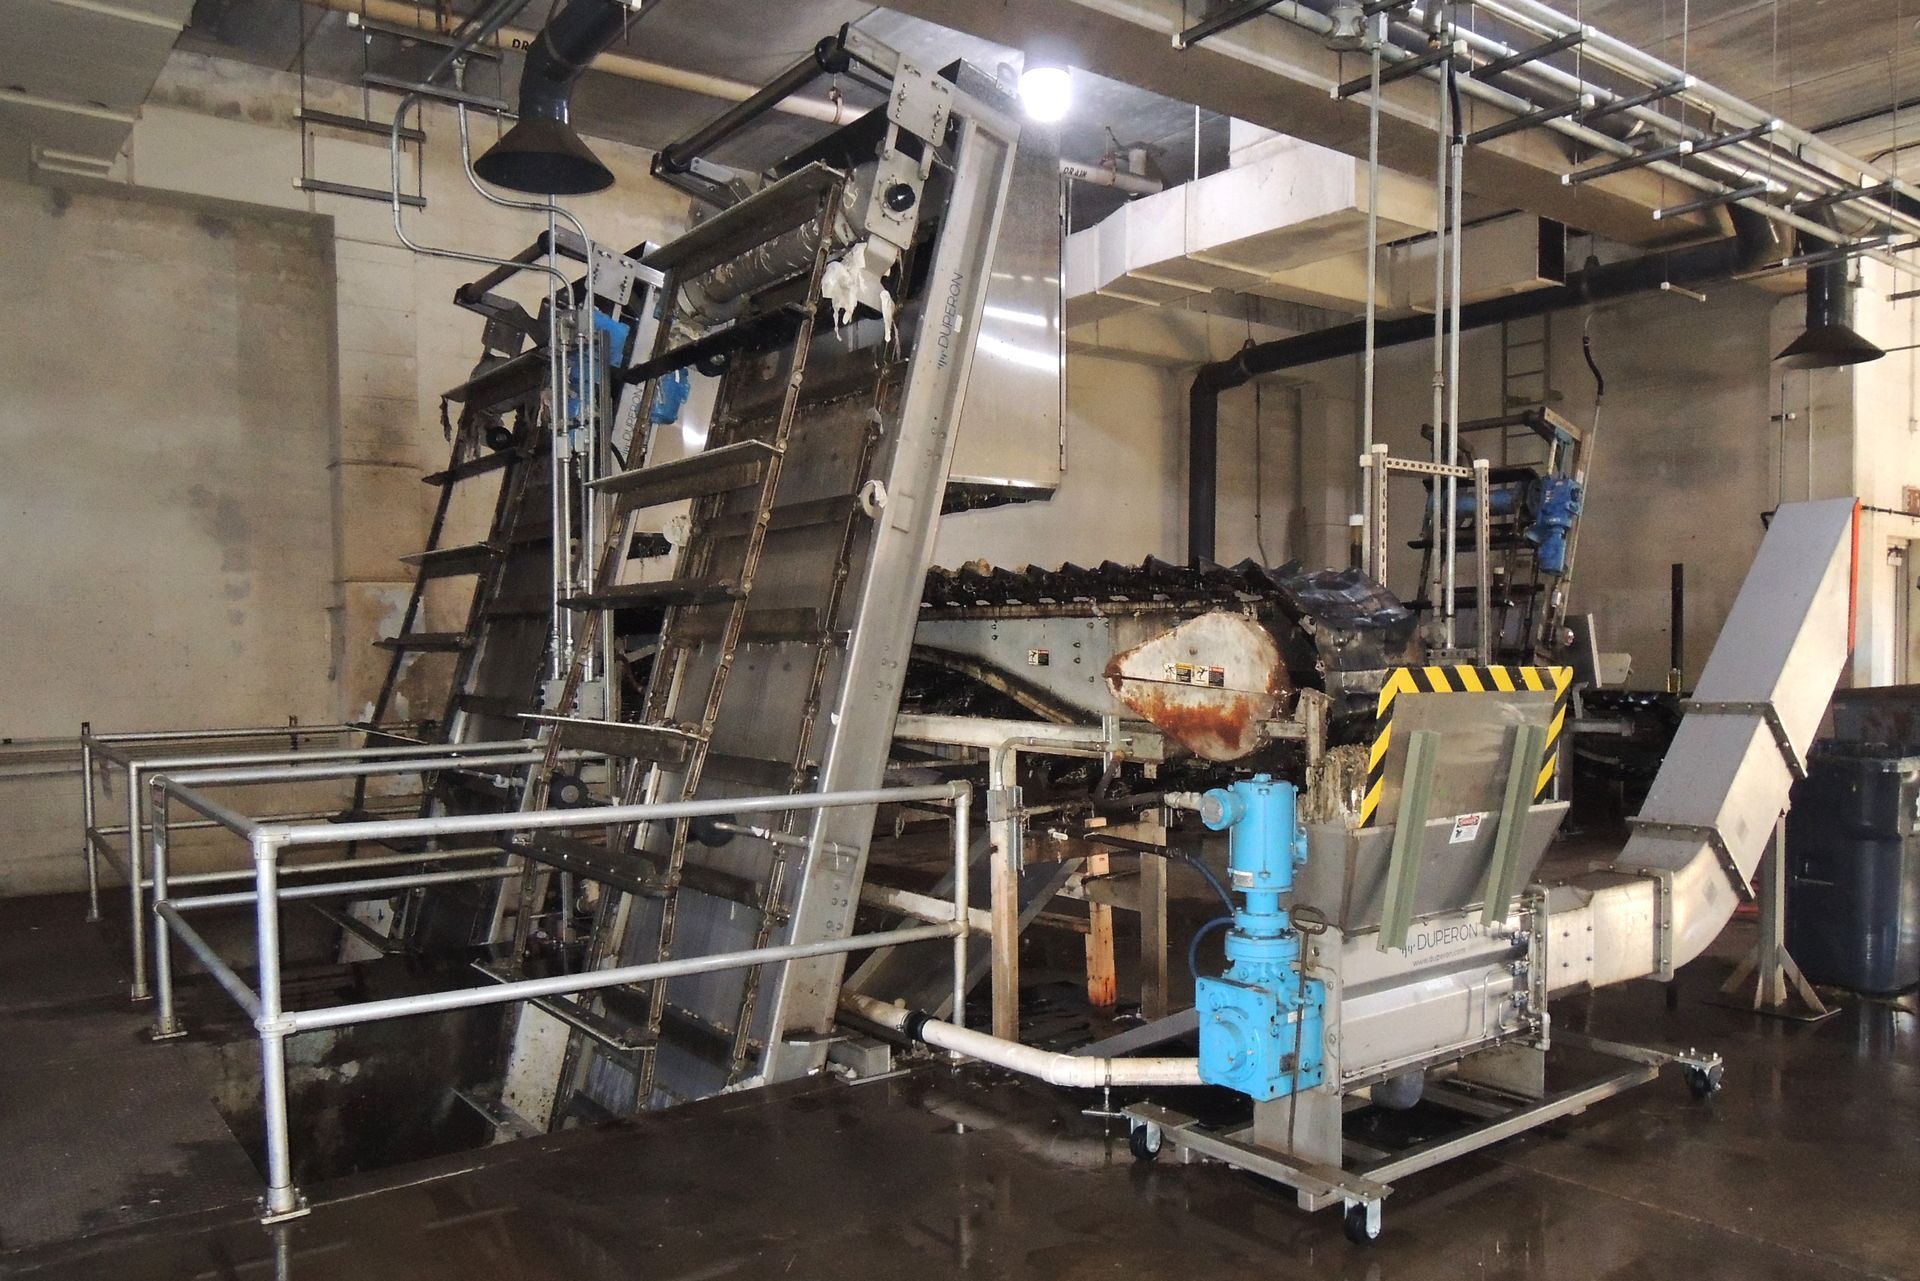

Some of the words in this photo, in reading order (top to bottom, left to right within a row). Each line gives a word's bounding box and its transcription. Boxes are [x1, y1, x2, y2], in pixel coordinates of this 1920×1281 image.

[1063, 166, 1088, 178] DRAIN
[938, 272, 963, 349] DUPERON
[1417, 922, 1478, 950] DUPERON
